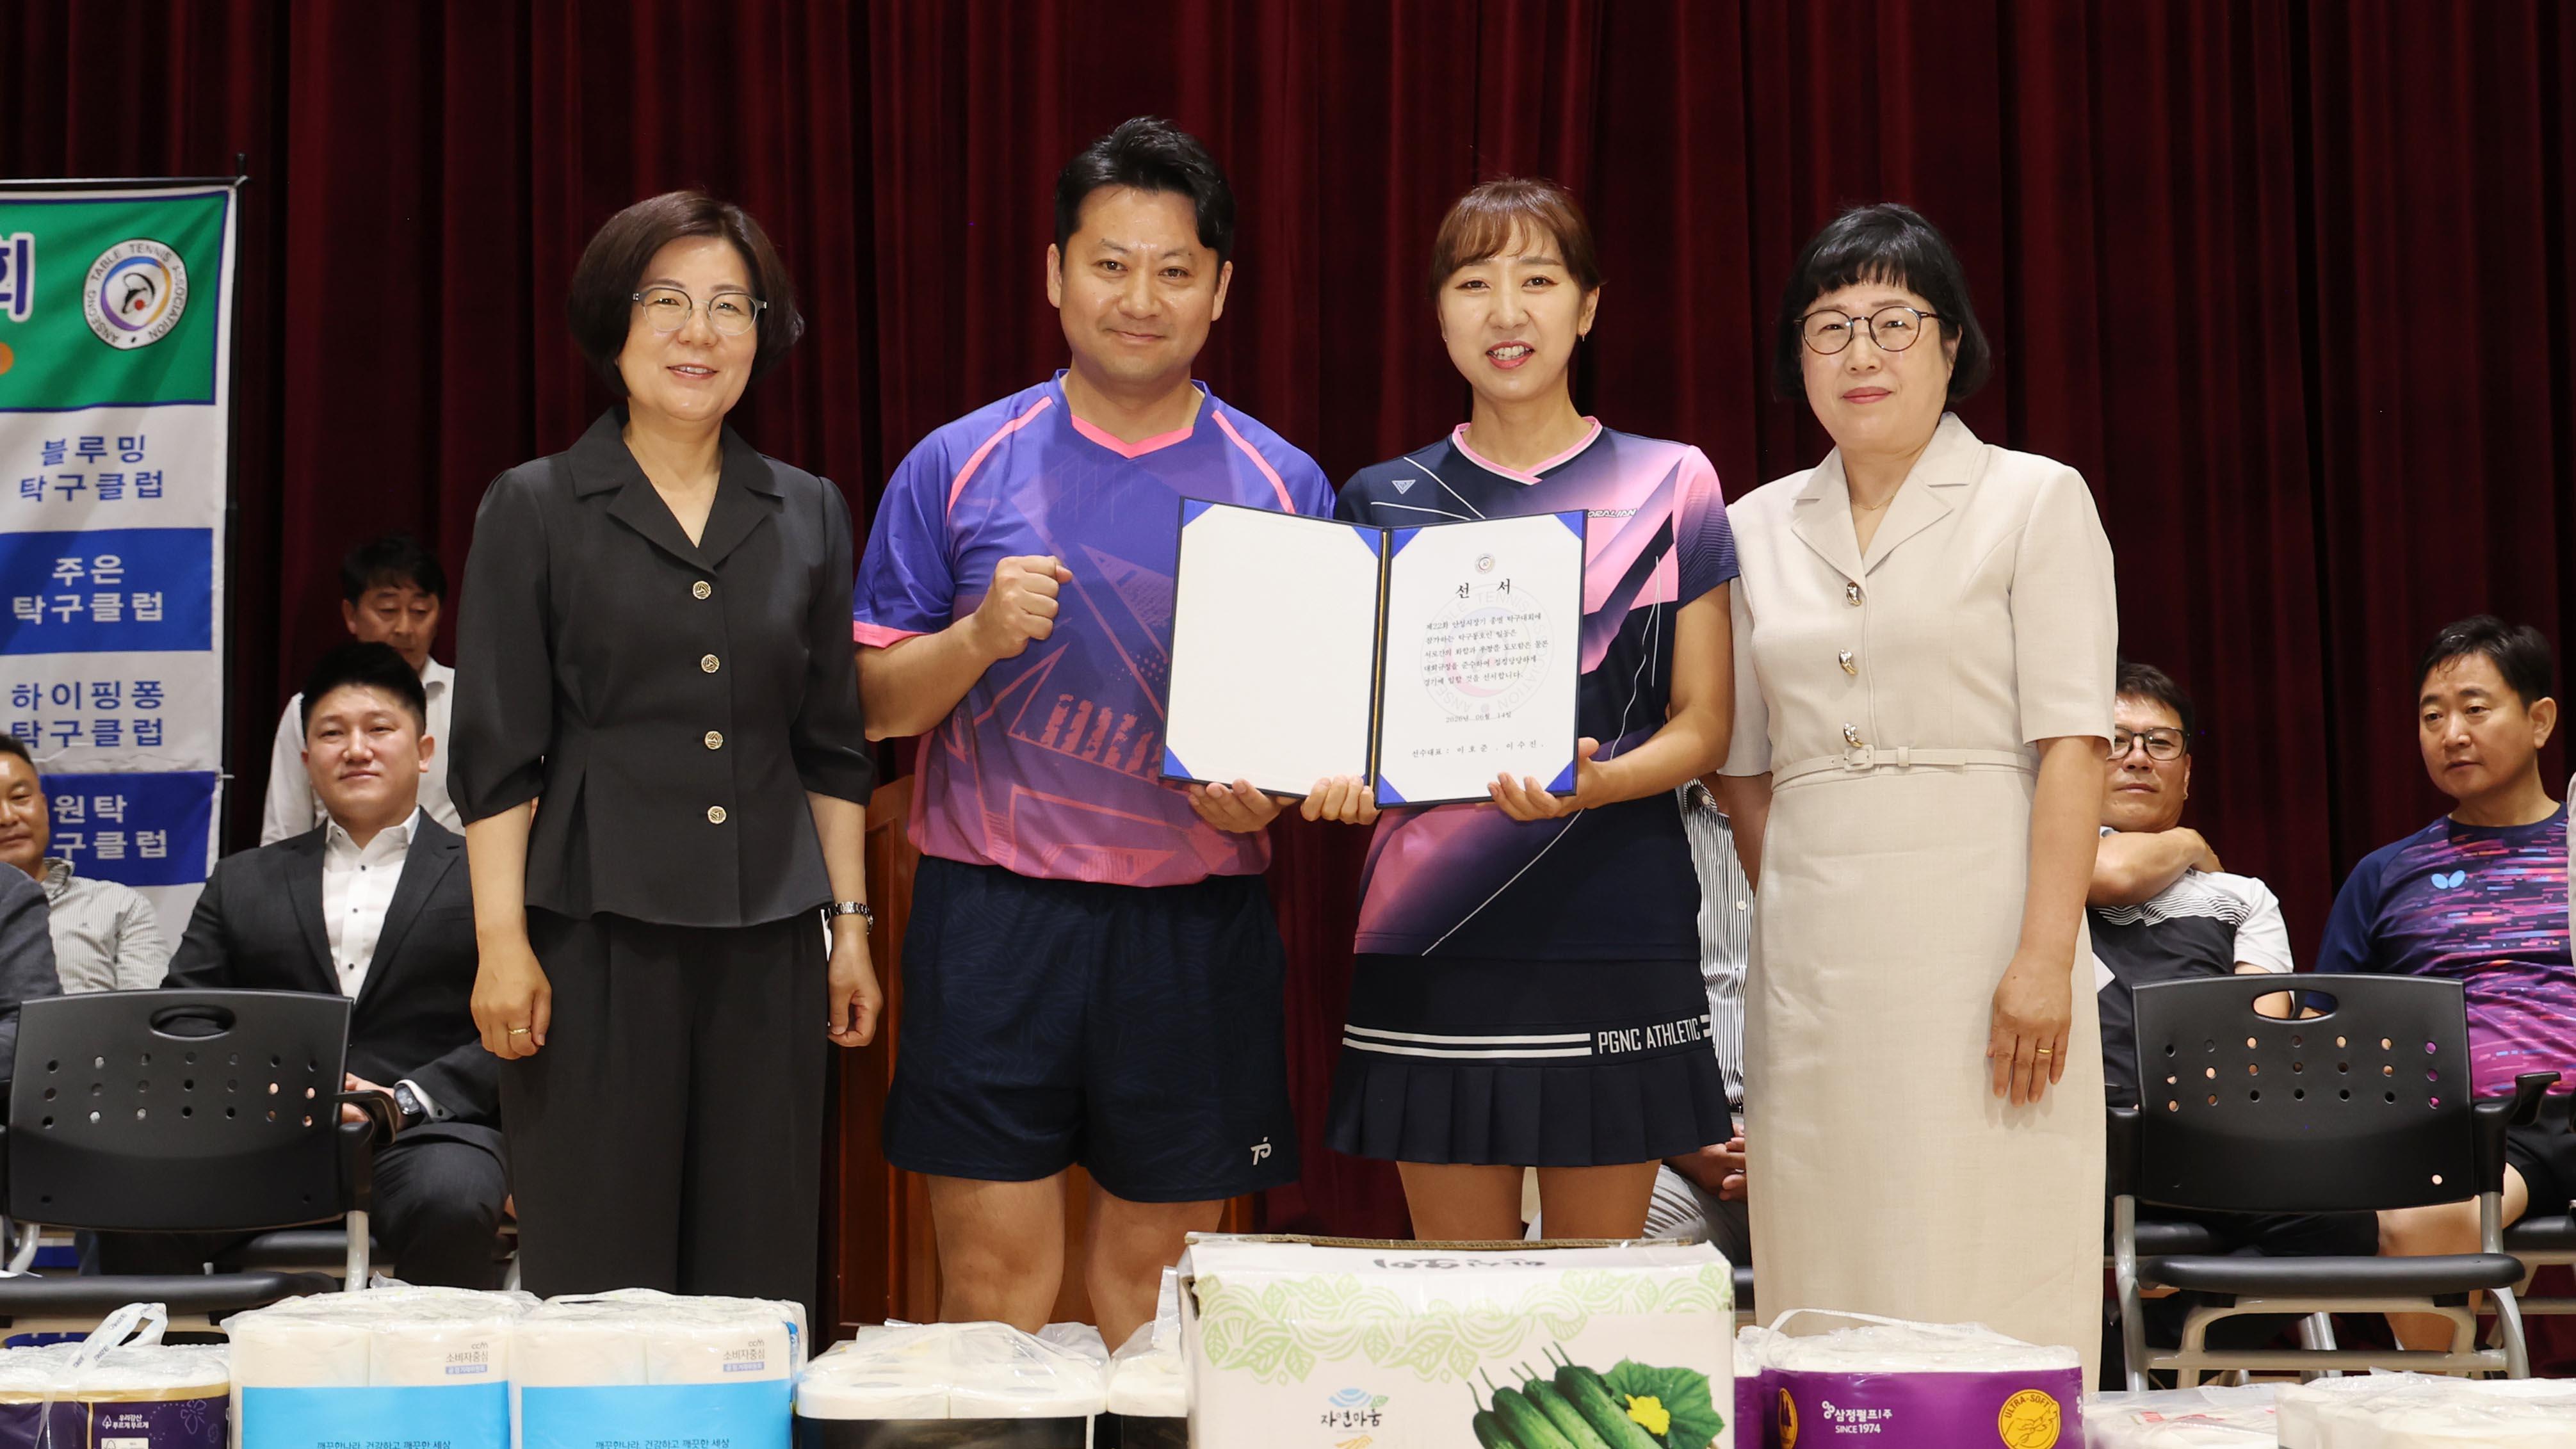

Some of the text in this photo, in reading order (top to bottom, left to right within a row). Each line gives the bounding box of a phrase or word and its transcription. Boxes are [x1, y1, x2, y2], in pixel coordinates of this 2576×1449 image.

[91, 249, 120, 281] TABLE
[129, 244, 172, 262] TENNIS
[87, 289, 120, 343] ANSEONG
[42, 435, 145, 467] 블루밍
[20, 470, 163, 502] 탁구클럽
[52, 554, 125, 587] 주은
[1455, 578, 1511, 599] 선 서
[12, 592, 163, 625] 탁구클럽
[11, 680, 165, 711] 하이핑퐁
[10, 717, 163, 749] 탁구클럽
[53, 794, 128, 824] 원탁
[53, 830, 168, 861] 구클럽
[1598, 1017, 1701, 1055] PGNC ATHLETIC
[446, 1350, 489, 1363] 소비자중심
[723, 1348, 765, 1361] 소비자중심
[645, 1439, 679, 1449] 건강하고
[683, 1439, 709, 1448] 깨끗한
[712, 1438, 730, 1448] 세상
[1835, 1423, 1881, 1434] SINCE 1974
[433, 1441, 451, 1449] 세상
